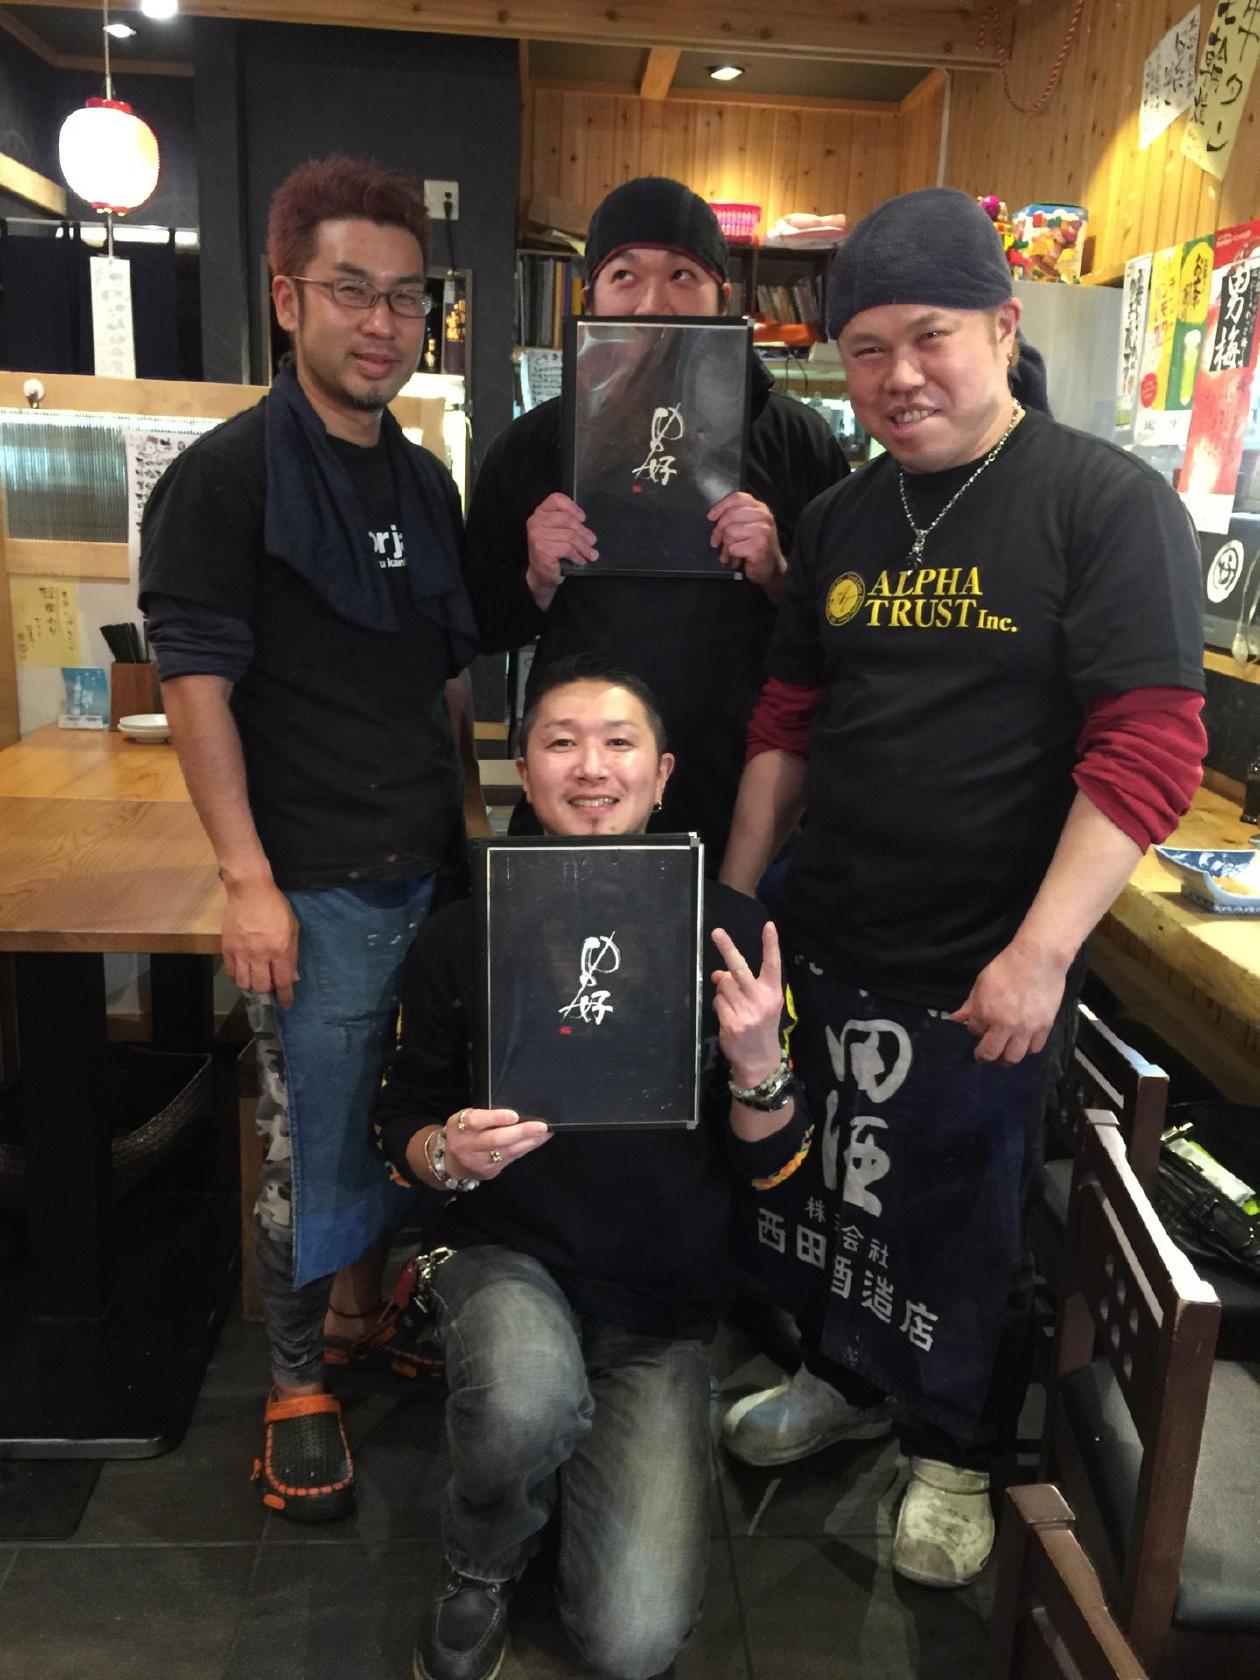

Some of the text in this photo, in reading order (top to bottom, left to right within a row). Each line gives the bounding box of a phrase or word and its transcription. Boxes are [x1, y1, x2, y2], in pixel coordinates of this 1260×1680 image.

[1212, 260, 1253, 371] 男梅
[867, 566, 984, 598] ALPHA
[864, 598, 977, 629] TRUST
[976, 609, 1019, 633] Inc.
